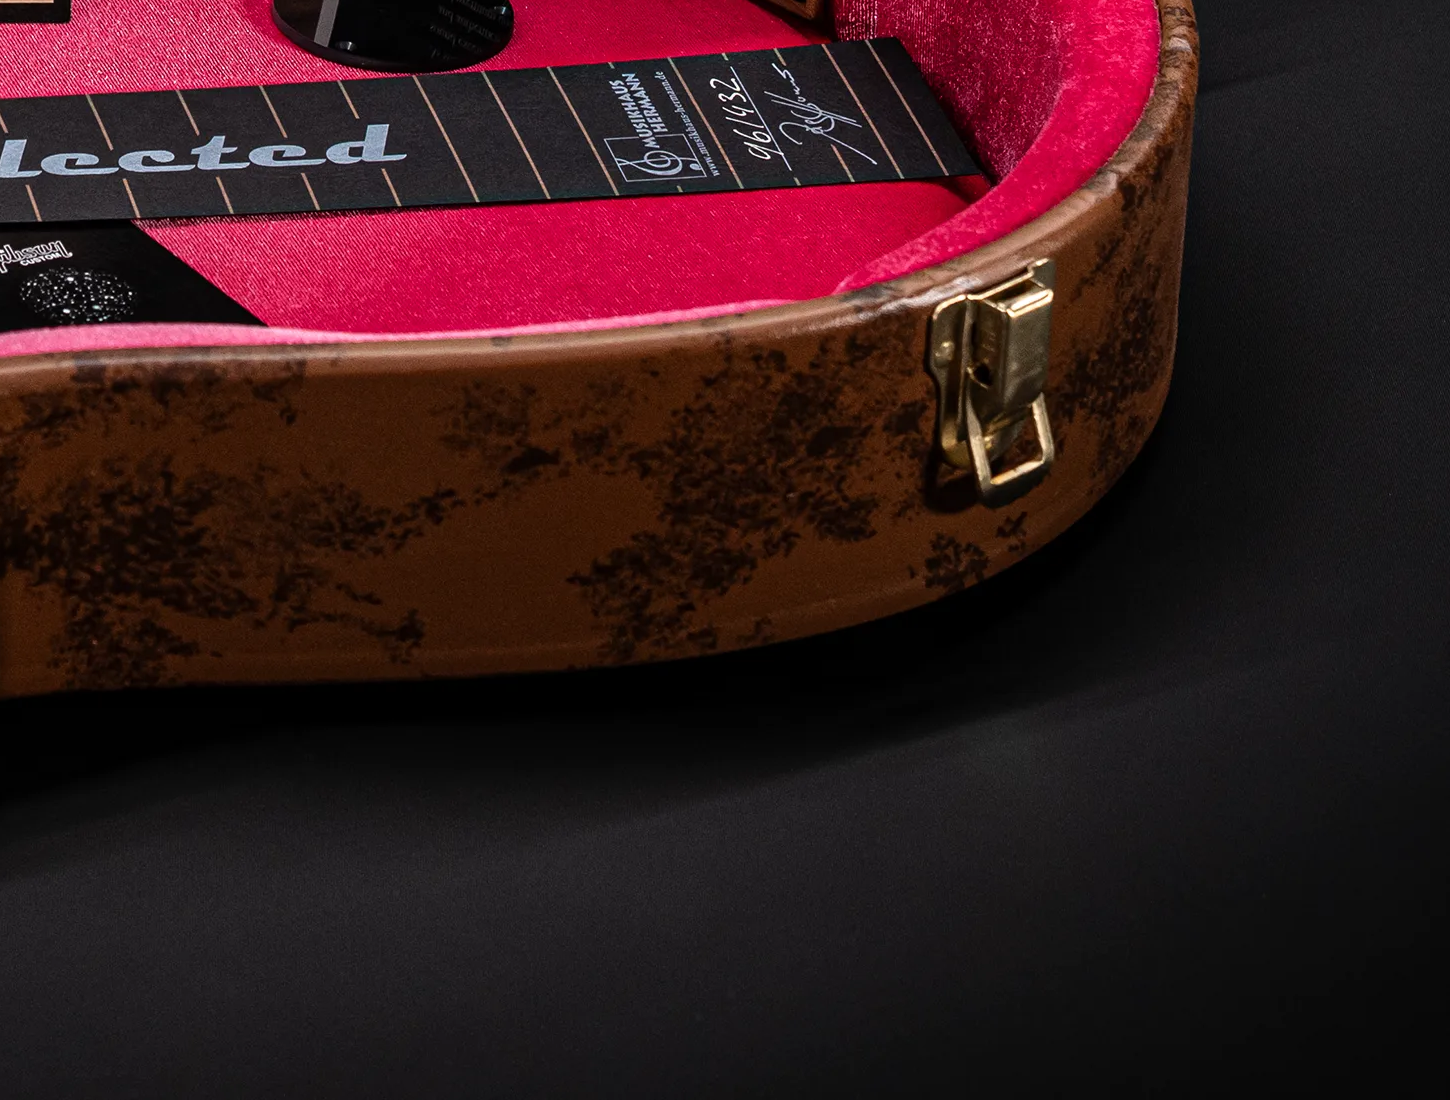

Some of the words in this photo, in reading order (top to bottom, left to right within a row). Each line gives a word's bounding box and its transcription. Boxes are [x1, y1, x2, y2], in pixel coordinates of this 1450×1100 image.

[609, 80, 661, 149] MUSIKHAUS
[622, 72, 669, 133] HERMANN
[709, 77, 784, 160] 961432
[20, 252, 62, 266] CUSTOM
